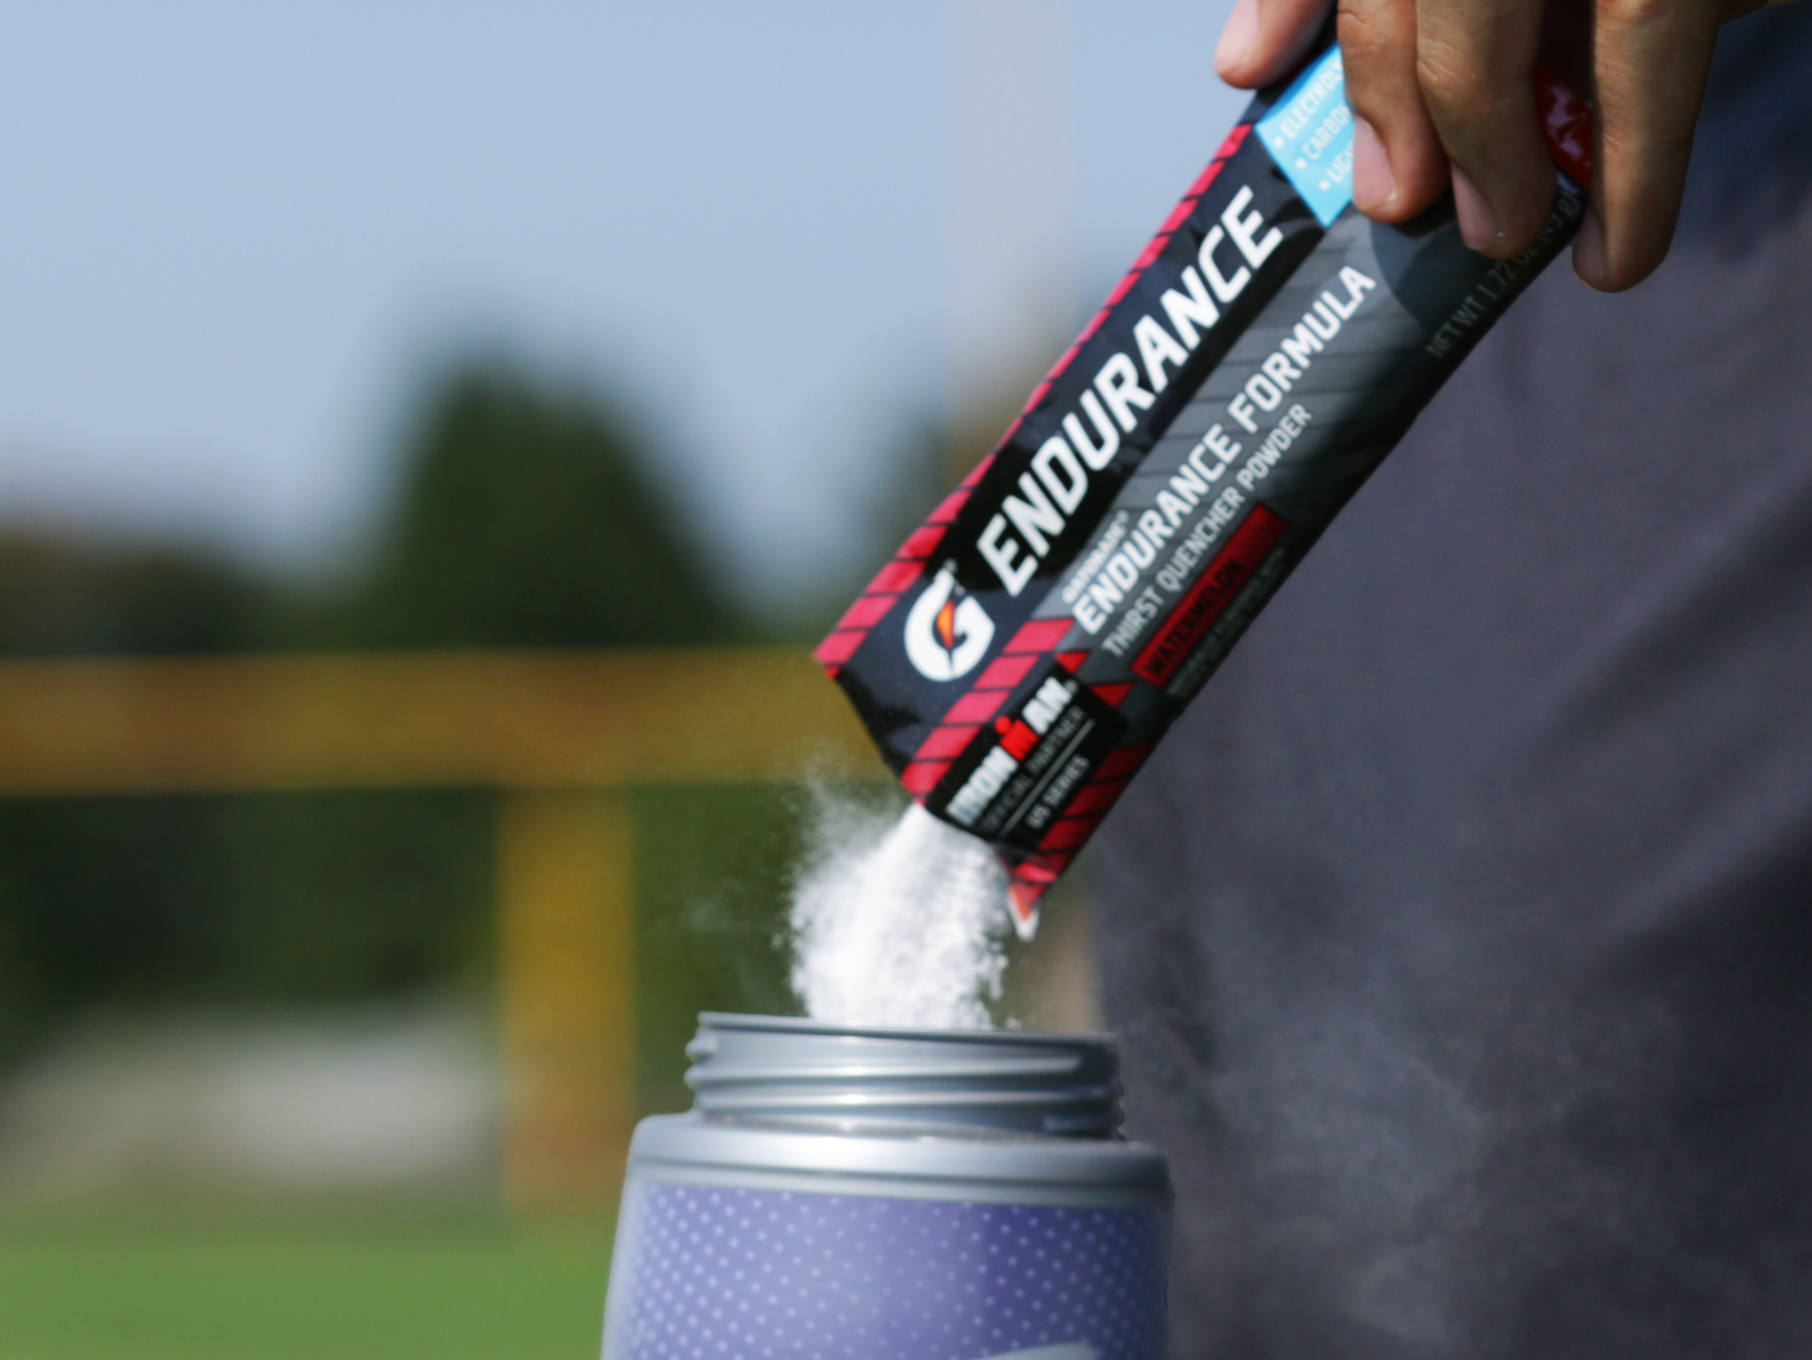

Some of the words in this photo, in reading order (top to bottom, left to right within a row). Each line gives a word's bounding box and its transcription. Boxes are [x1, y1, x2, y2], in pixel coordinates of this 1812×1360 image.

[1424, 319, 1462, 357] NET
[1449, 292, 1488, 328] WT
[1475, 259, 1518, 300] 1.72
[904, 565, 995, 680] G
[975, 184, 1284, 598] ENDURANCE
[1068, 420, 1244, 637] ENDURANCE
[1225, 263, 1377, 434] FORMULA
[1100, 583, 1166, 658] THIRST
[1153, 484, 1246, 593] QUENCHER
[1235, 401, 1314, 491] POWDER
[1142, 555, 1244, 677] WATERMELON
[1023, 800, 1053, 830] US
[1039, 752, 1091, 809] SERIES
[1024, 703, 1086, 776] PARTNER
